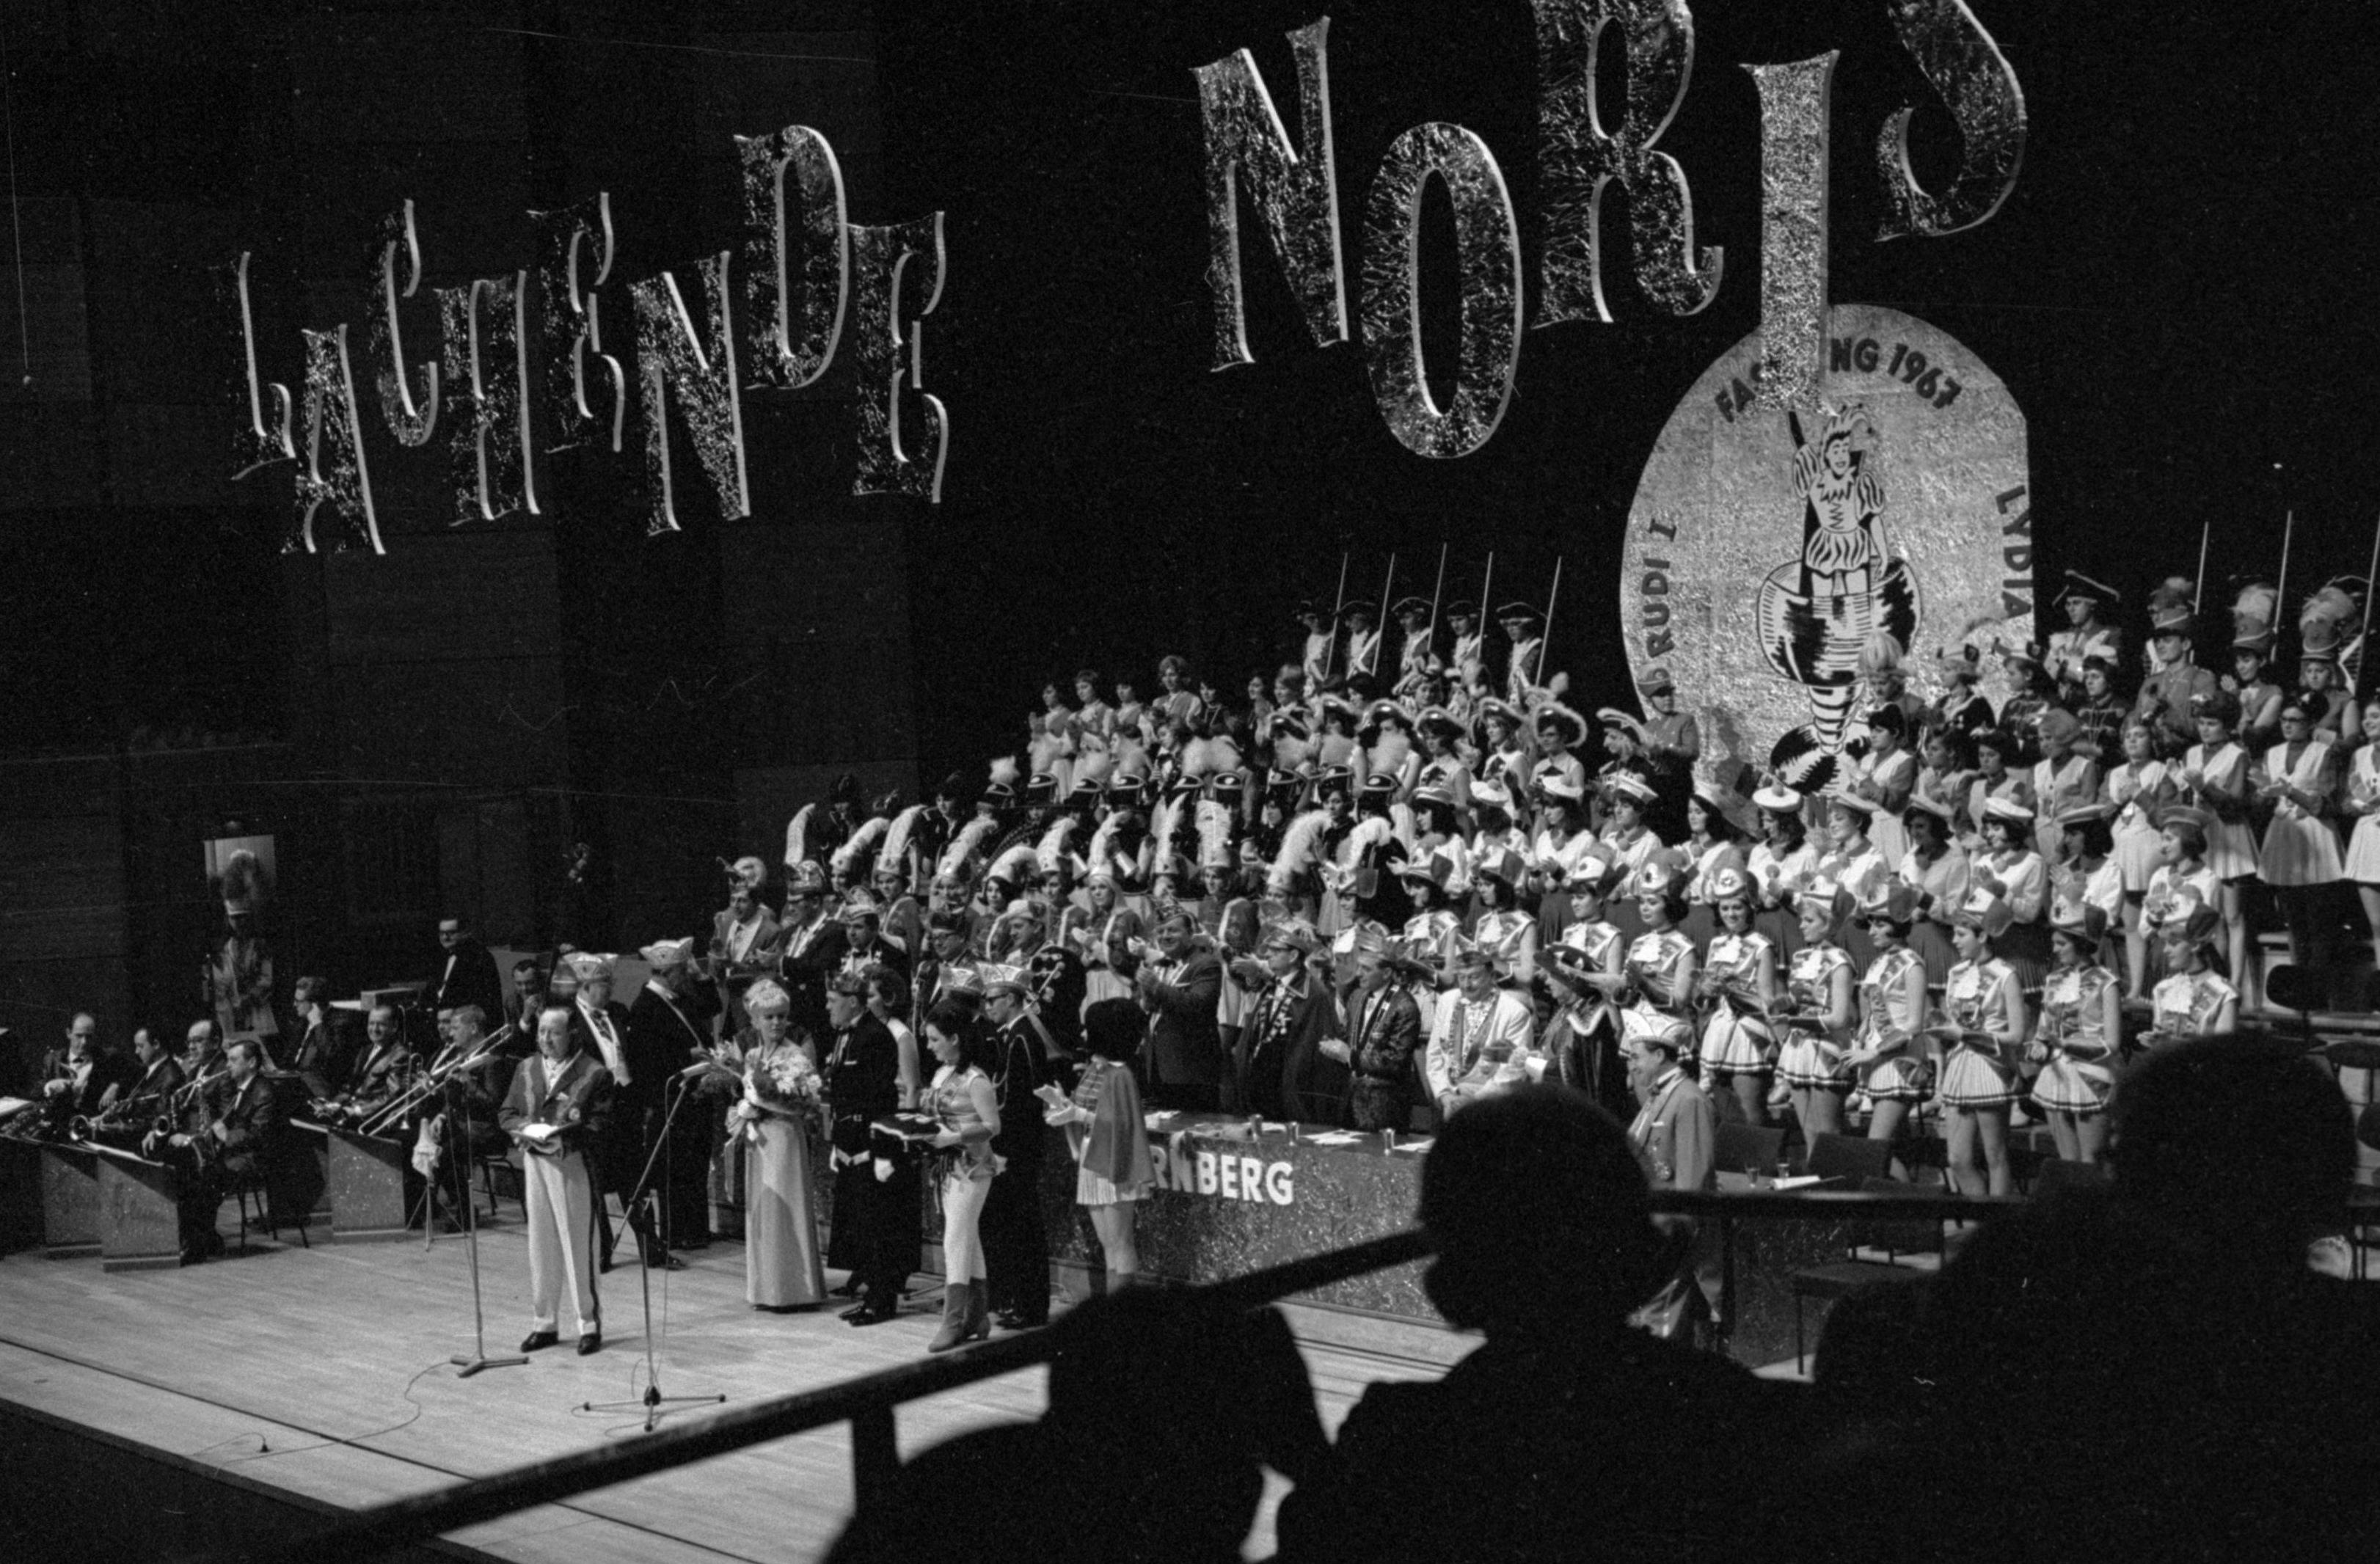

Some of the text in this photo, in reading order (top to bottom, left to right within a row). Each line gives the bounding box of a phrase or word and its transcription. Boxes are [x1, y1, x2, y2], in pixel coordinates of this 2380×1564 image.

[210, 0, 2028, 555] LACHENDE NORIS
[1714, 337, 1963, 423] FANG 1967
[1640, 518, 1677, 658] RUDI I
[1995, 484, 2033, 623] LYDIA
[1149, 1144, 1294, 1205] RNBERG
